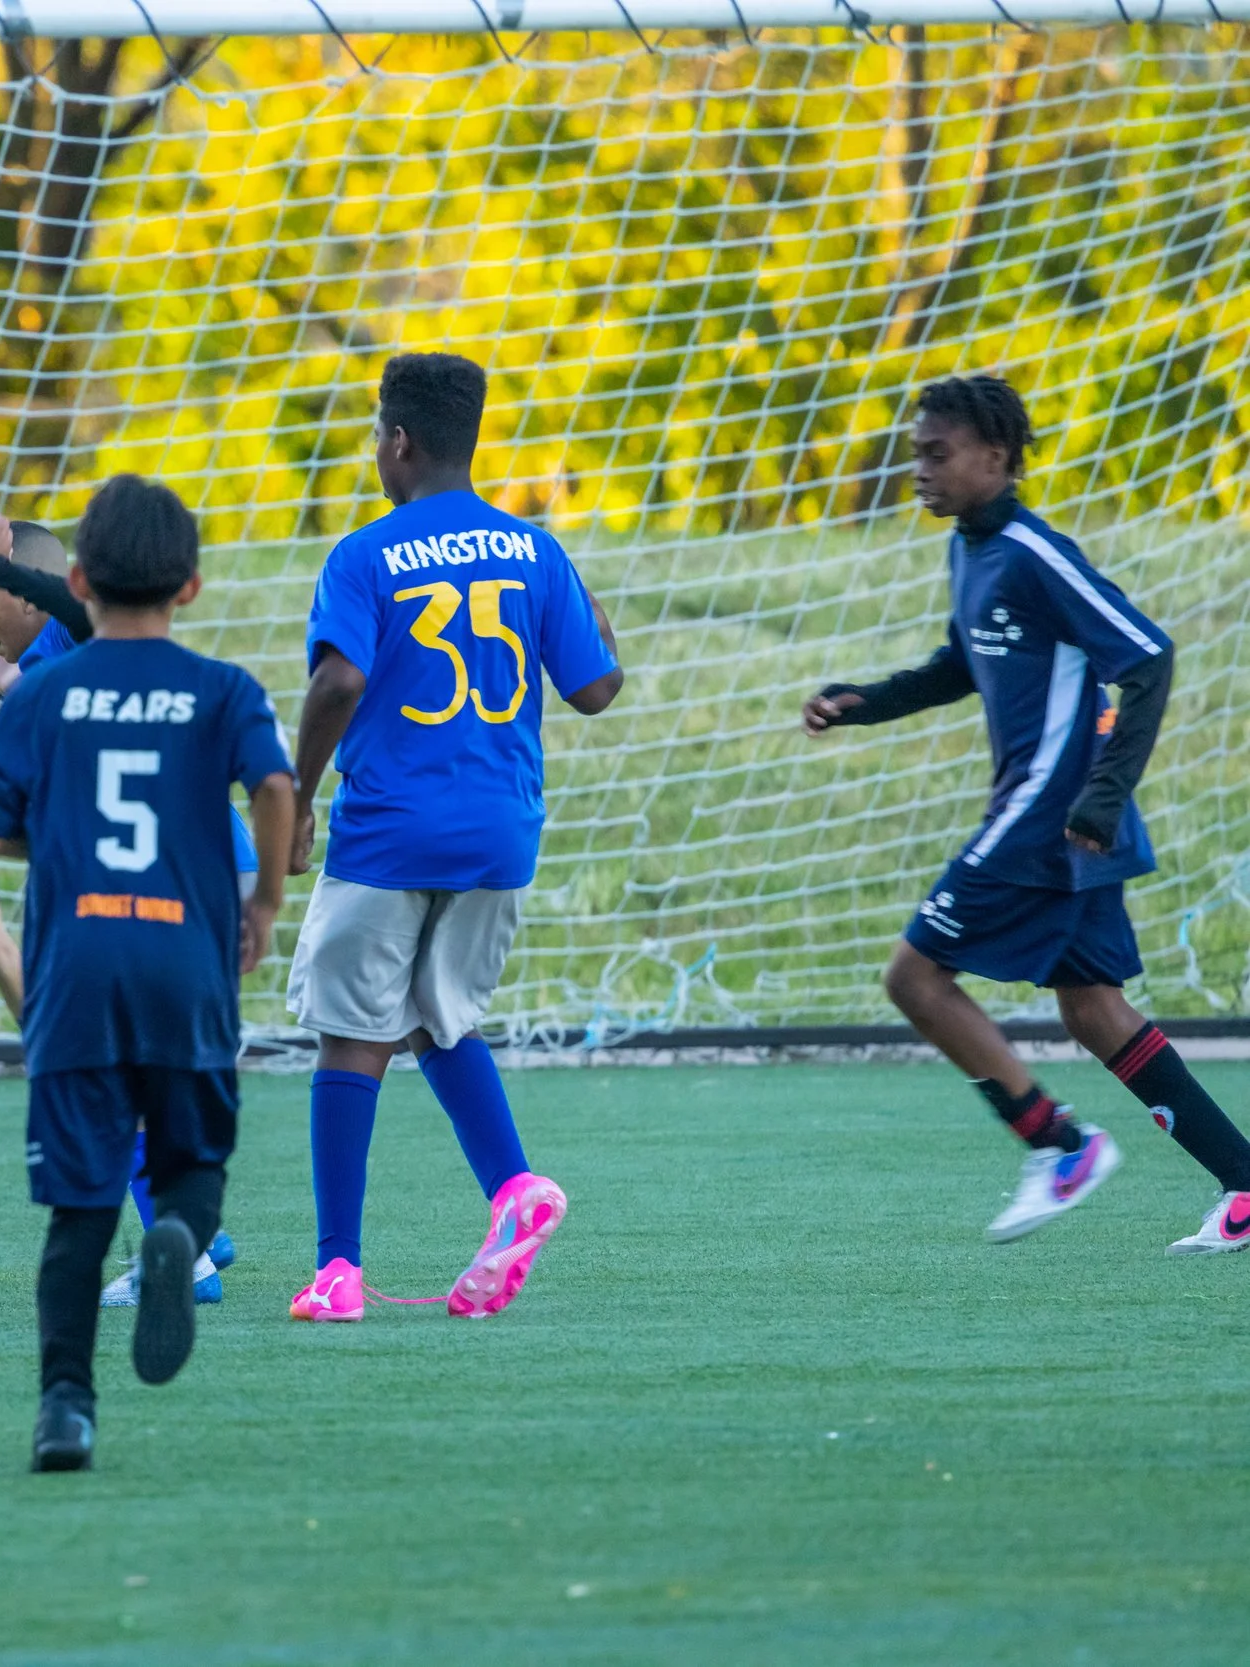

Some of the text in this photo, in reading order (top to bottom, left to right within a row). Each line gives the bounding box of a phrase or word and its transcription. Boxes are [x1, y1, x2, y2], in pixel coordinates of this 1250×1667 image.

[382, 529, 538, 576] KINGSTON
[393, 579, 529, 726] 35
[61, 686, 197, 724] BEARS
[95, 748, 161, 873] 5
